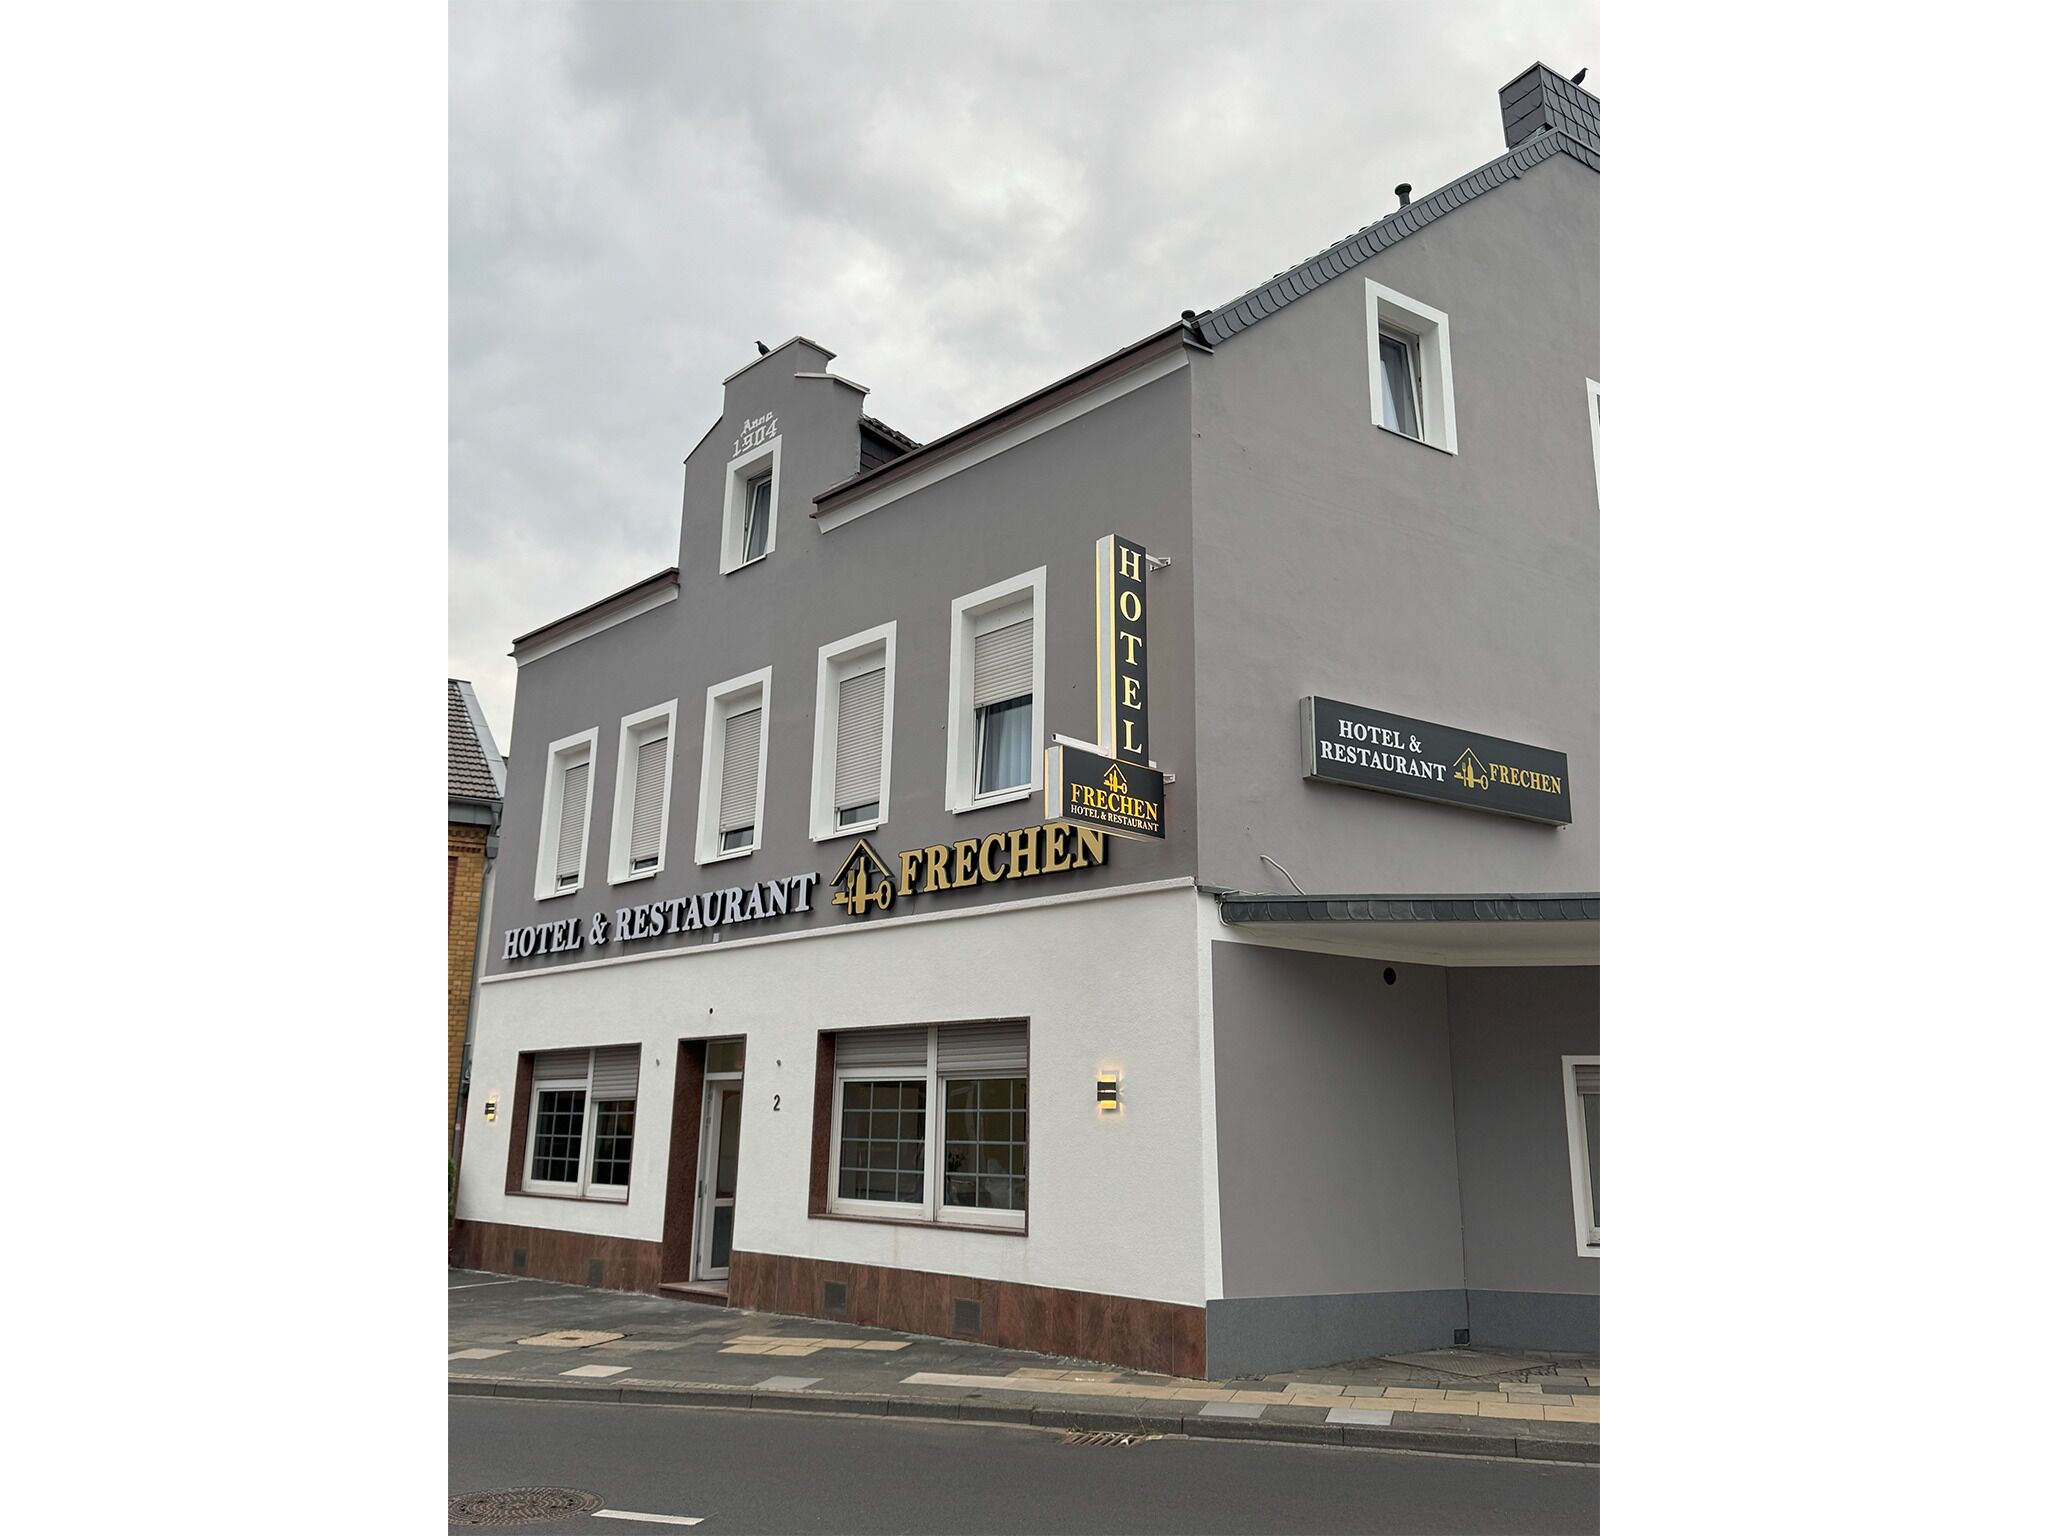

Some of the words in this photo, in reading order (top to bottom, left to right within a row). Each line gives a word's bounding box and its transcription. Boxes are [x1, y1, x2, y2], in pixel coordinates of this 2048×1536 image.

[732, 417, 778, 458] 1904
[1119, 545, 1143, 754] HOTEL
[1338, 719, 1404, 750] HOTEL
[1409, 734, 1423, 754] &
[1320, 741, 1446, 782] RESTAURANT
[1489, 763, 1561, 794] FRECHEN
[1070, 782, 1159, 821] FRECHEN
[1070, 804, 1100, 819] HOTEL
[1100, 810, 1107, 821] &
[1107, 812, 1160, 832] RESTAURANT
[501, 918, 583, 960] HOTEL
[588, 911, 612, 945] &
[613, 872, 819, 941] RESTAURANT
[897, 822, 1105, 896] FRECHEN
[773, 1094, 781, 1112] 2
